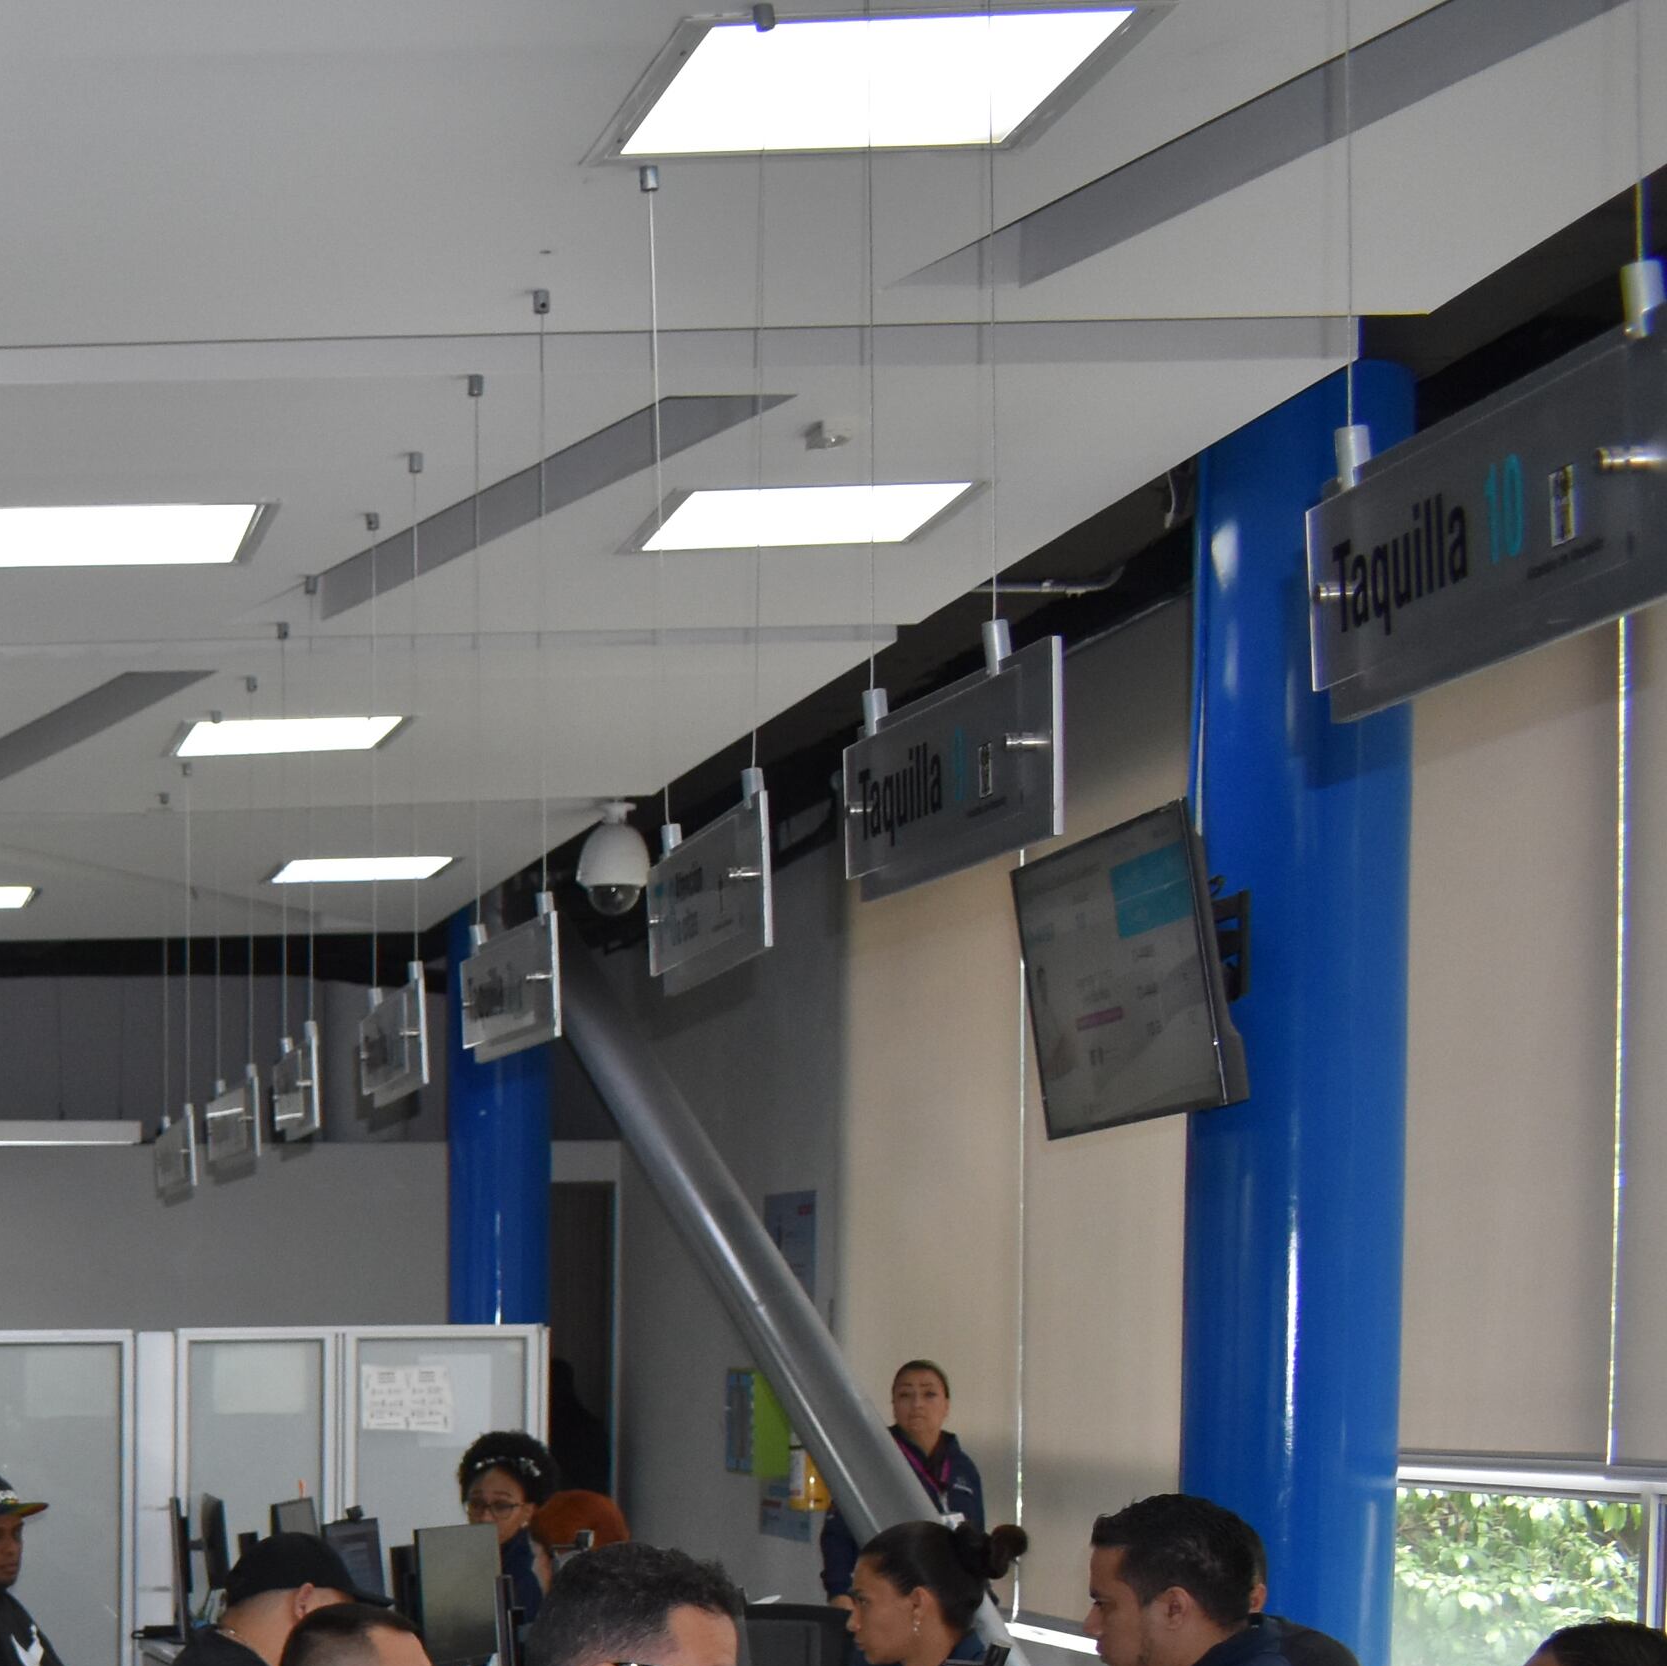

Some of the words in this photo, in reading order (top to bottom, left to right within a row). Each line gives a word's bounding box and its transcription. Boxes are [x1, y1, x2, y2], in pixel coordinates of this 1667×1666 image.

[1332, 492, 1468, 635] Taquilla
[1484, 453, 1526, 565] 10
[858, 741, 944, 847] Taquilla
